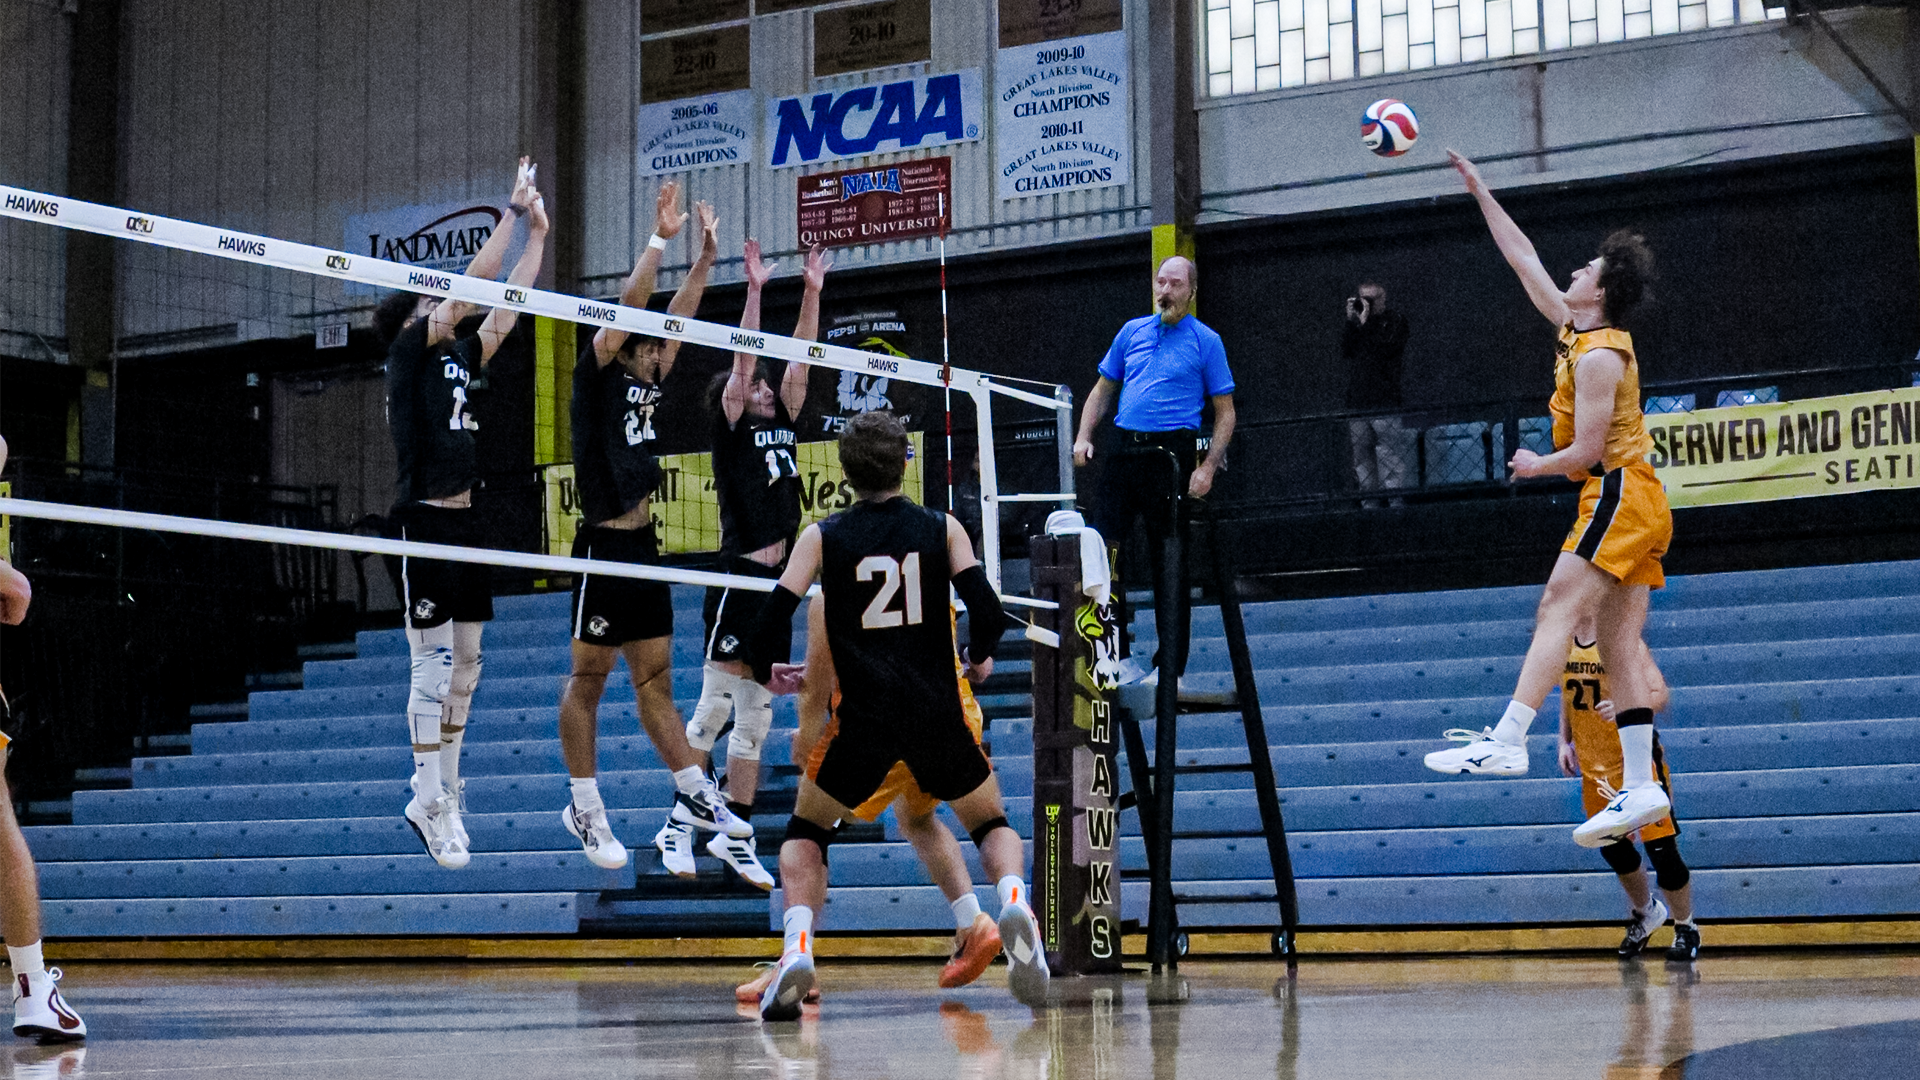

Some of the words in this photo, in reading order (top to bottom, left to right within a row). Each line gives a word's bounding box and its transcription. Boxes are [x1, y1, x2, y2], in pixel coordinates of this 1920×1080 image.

[1037, 45, 1085, 65] 2009-10
[1003, 74, 1037, 101] GREAT
[1040, 65, 1077, 80] LAKES
[1081, 65, 1121, 85] VALLEY
[1030, 86, 1055, 98] North
[1058, 83, 1093, 94] Division
[671, 102, 718, 120] 2005-06
[1013, 91, 1110, 118] CHAMPIONS
[771, 74, 964, 166] NCAA
[1041, 120, 1084, 139] 2010-11
[643, 127, 673, 154] GREAT
[676, 120, 709, 135] LAKES
[713, 121, 746, 140] VALLEY
[695, 137, 727, 147] Division
[652, 146, 738, 170] CHAMPIONS
[902, 165, 932, 175] National
[1003, 149, 1037, 177] GREAT
[1041, 141, 1078, 155] LAKES
[1082, 141, 1122, 161] VALLEY
[1031, 163, 1056, 174] North
[1058, 159, 1094, 170] Division
[819, 177, 838, 188] Men's
[841, 168, 903, 201] NAIA
[1014, 167, 1112, 192] CHAMPIONS
[801, 227, 855, 246] QUINCY
[5, 194, 59, 217] HAWKS
[218, 235, 266, 256] HAWKS
[408, 271, 451, 291] HAWKS
[577, 304, 617, 321] HAWKS
[730, 332, 765, 349] HAWKS
[867, 357, 899, 373] HAWKS
[827, 325, 857, 340] PEPSI
[872, 322, 906, 332] ARENA
[1776, 409, 1842, 457] AND
[856, 551, 923, 629] 21
[1565, 678, 1601, 711] 27
[1086, 700, 1115, 958] HAWKS
